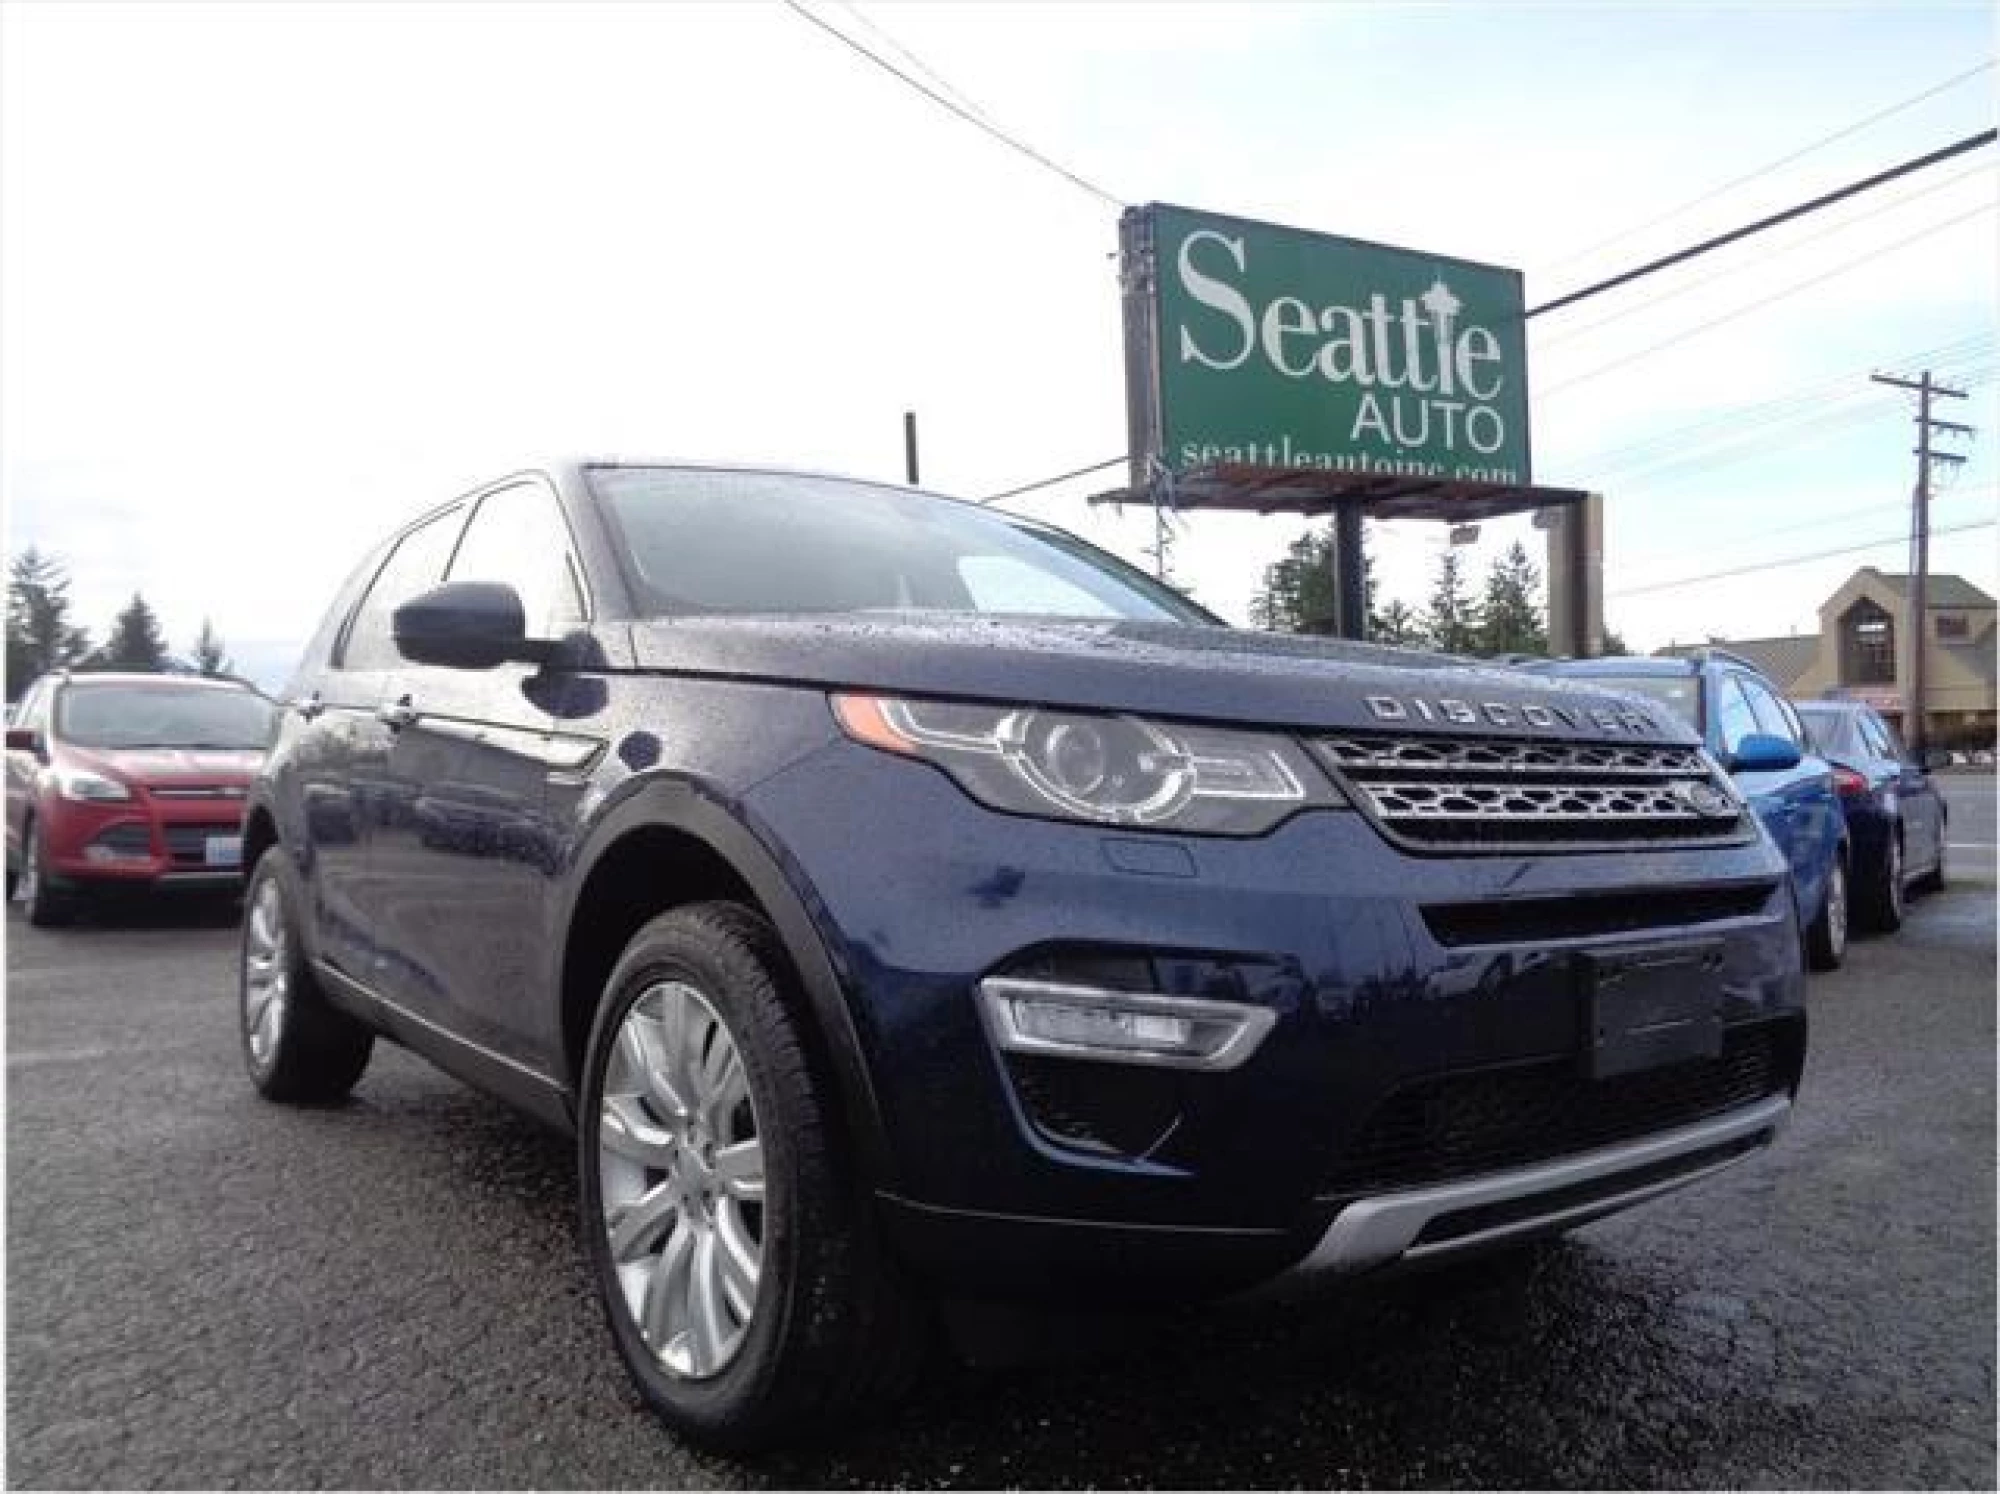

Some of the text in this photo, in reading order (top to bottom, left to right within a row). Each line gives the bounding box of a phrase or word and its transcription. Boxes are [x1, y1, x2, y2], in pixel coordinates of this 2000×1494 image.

[1178, 230, 1502, 400] Seattle
[1350, 393, 1505, 454] AUTO
[1181, 434, 1517, 483] seattleautoinccom
